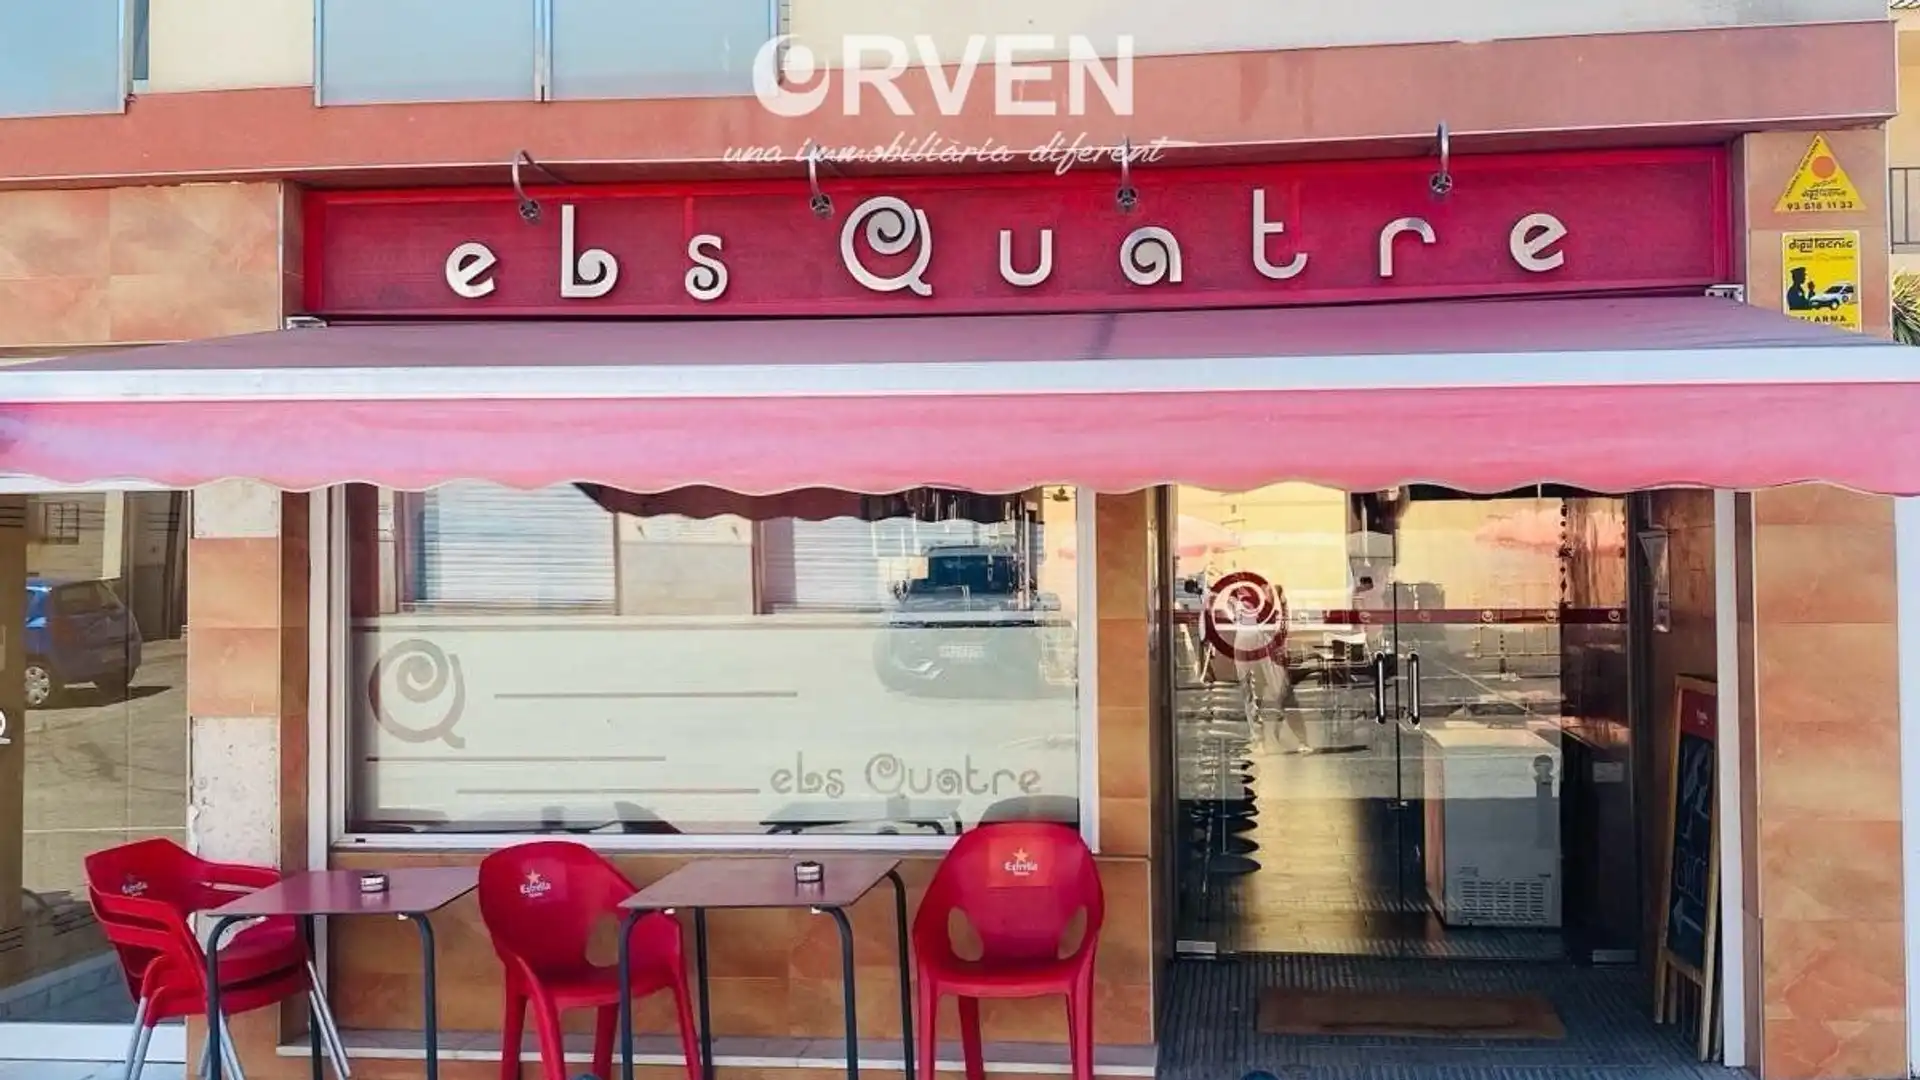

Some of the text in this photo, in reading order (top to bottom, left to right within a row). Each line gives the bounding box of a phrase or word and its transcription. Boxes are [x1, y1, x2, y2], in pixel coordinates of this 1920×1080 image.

[1827, 201, 1837, 209] 11
[840, 188, 1568, 297] Quatre
[865, 753, 1042, 799] Quatre
